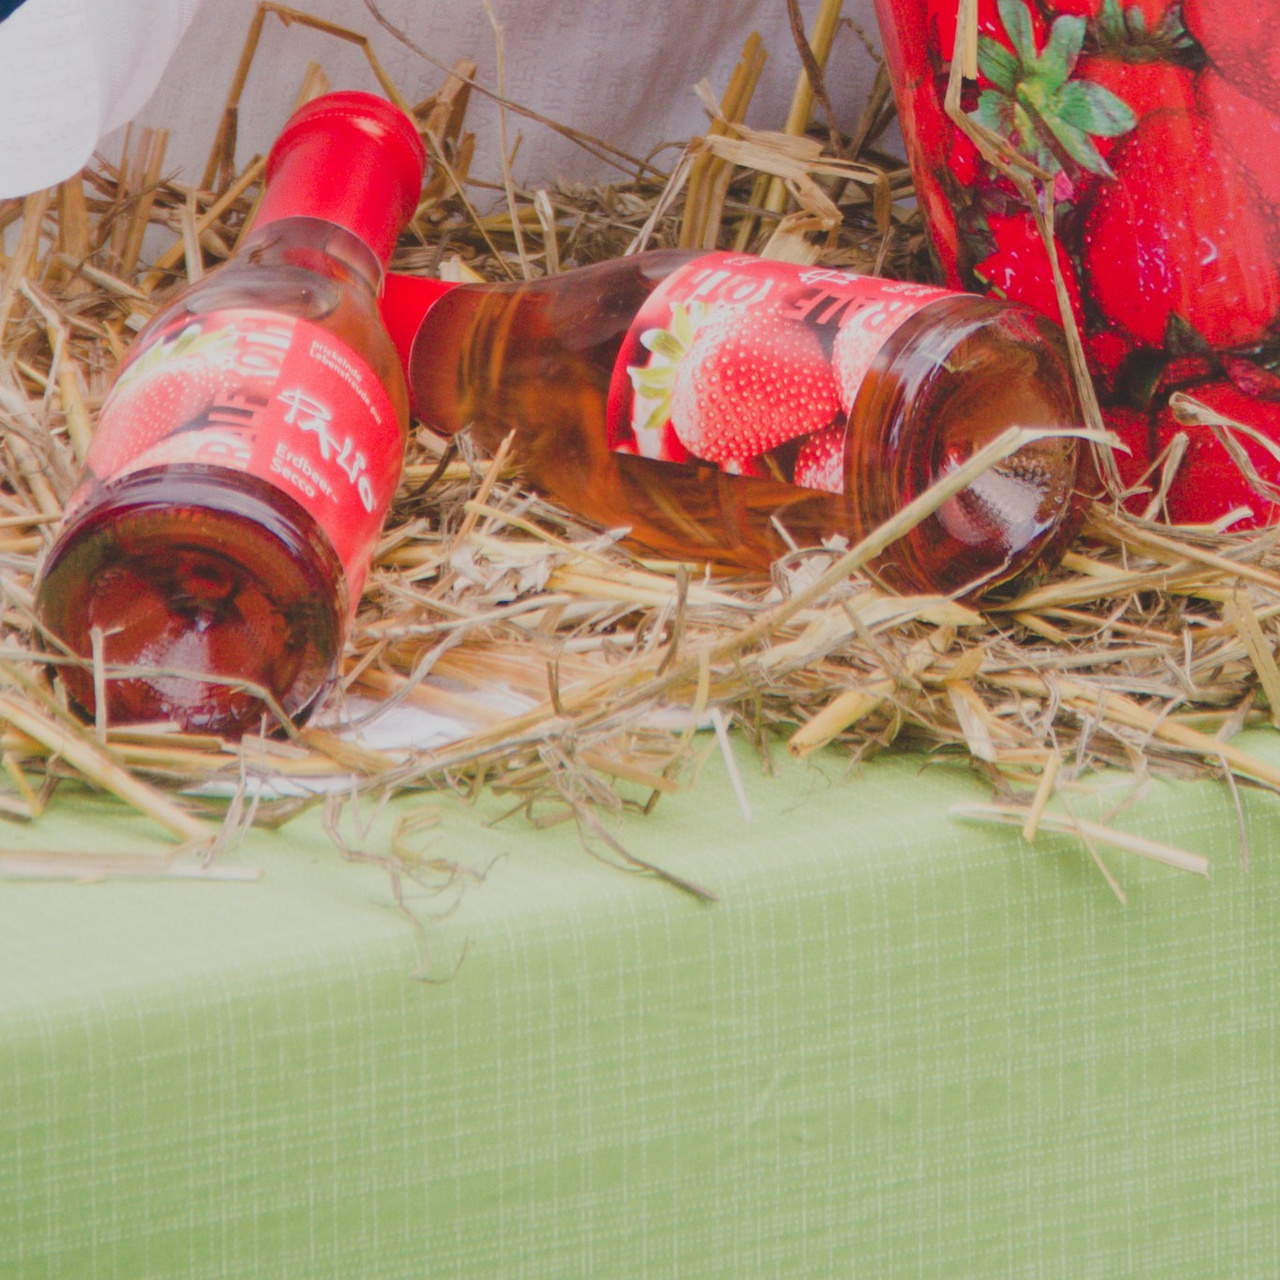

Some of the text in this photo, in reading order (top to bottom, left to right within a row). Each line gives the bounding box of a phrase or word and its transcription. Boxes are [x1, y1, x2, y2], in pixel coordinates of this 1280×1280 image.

[309, 347, 371, 406] Lebensfreude
[312, 340, 362, 382] prickelnde
[269, 457, 315, 499] Secco
[274, 441, 339, 504] Erdbeer-
